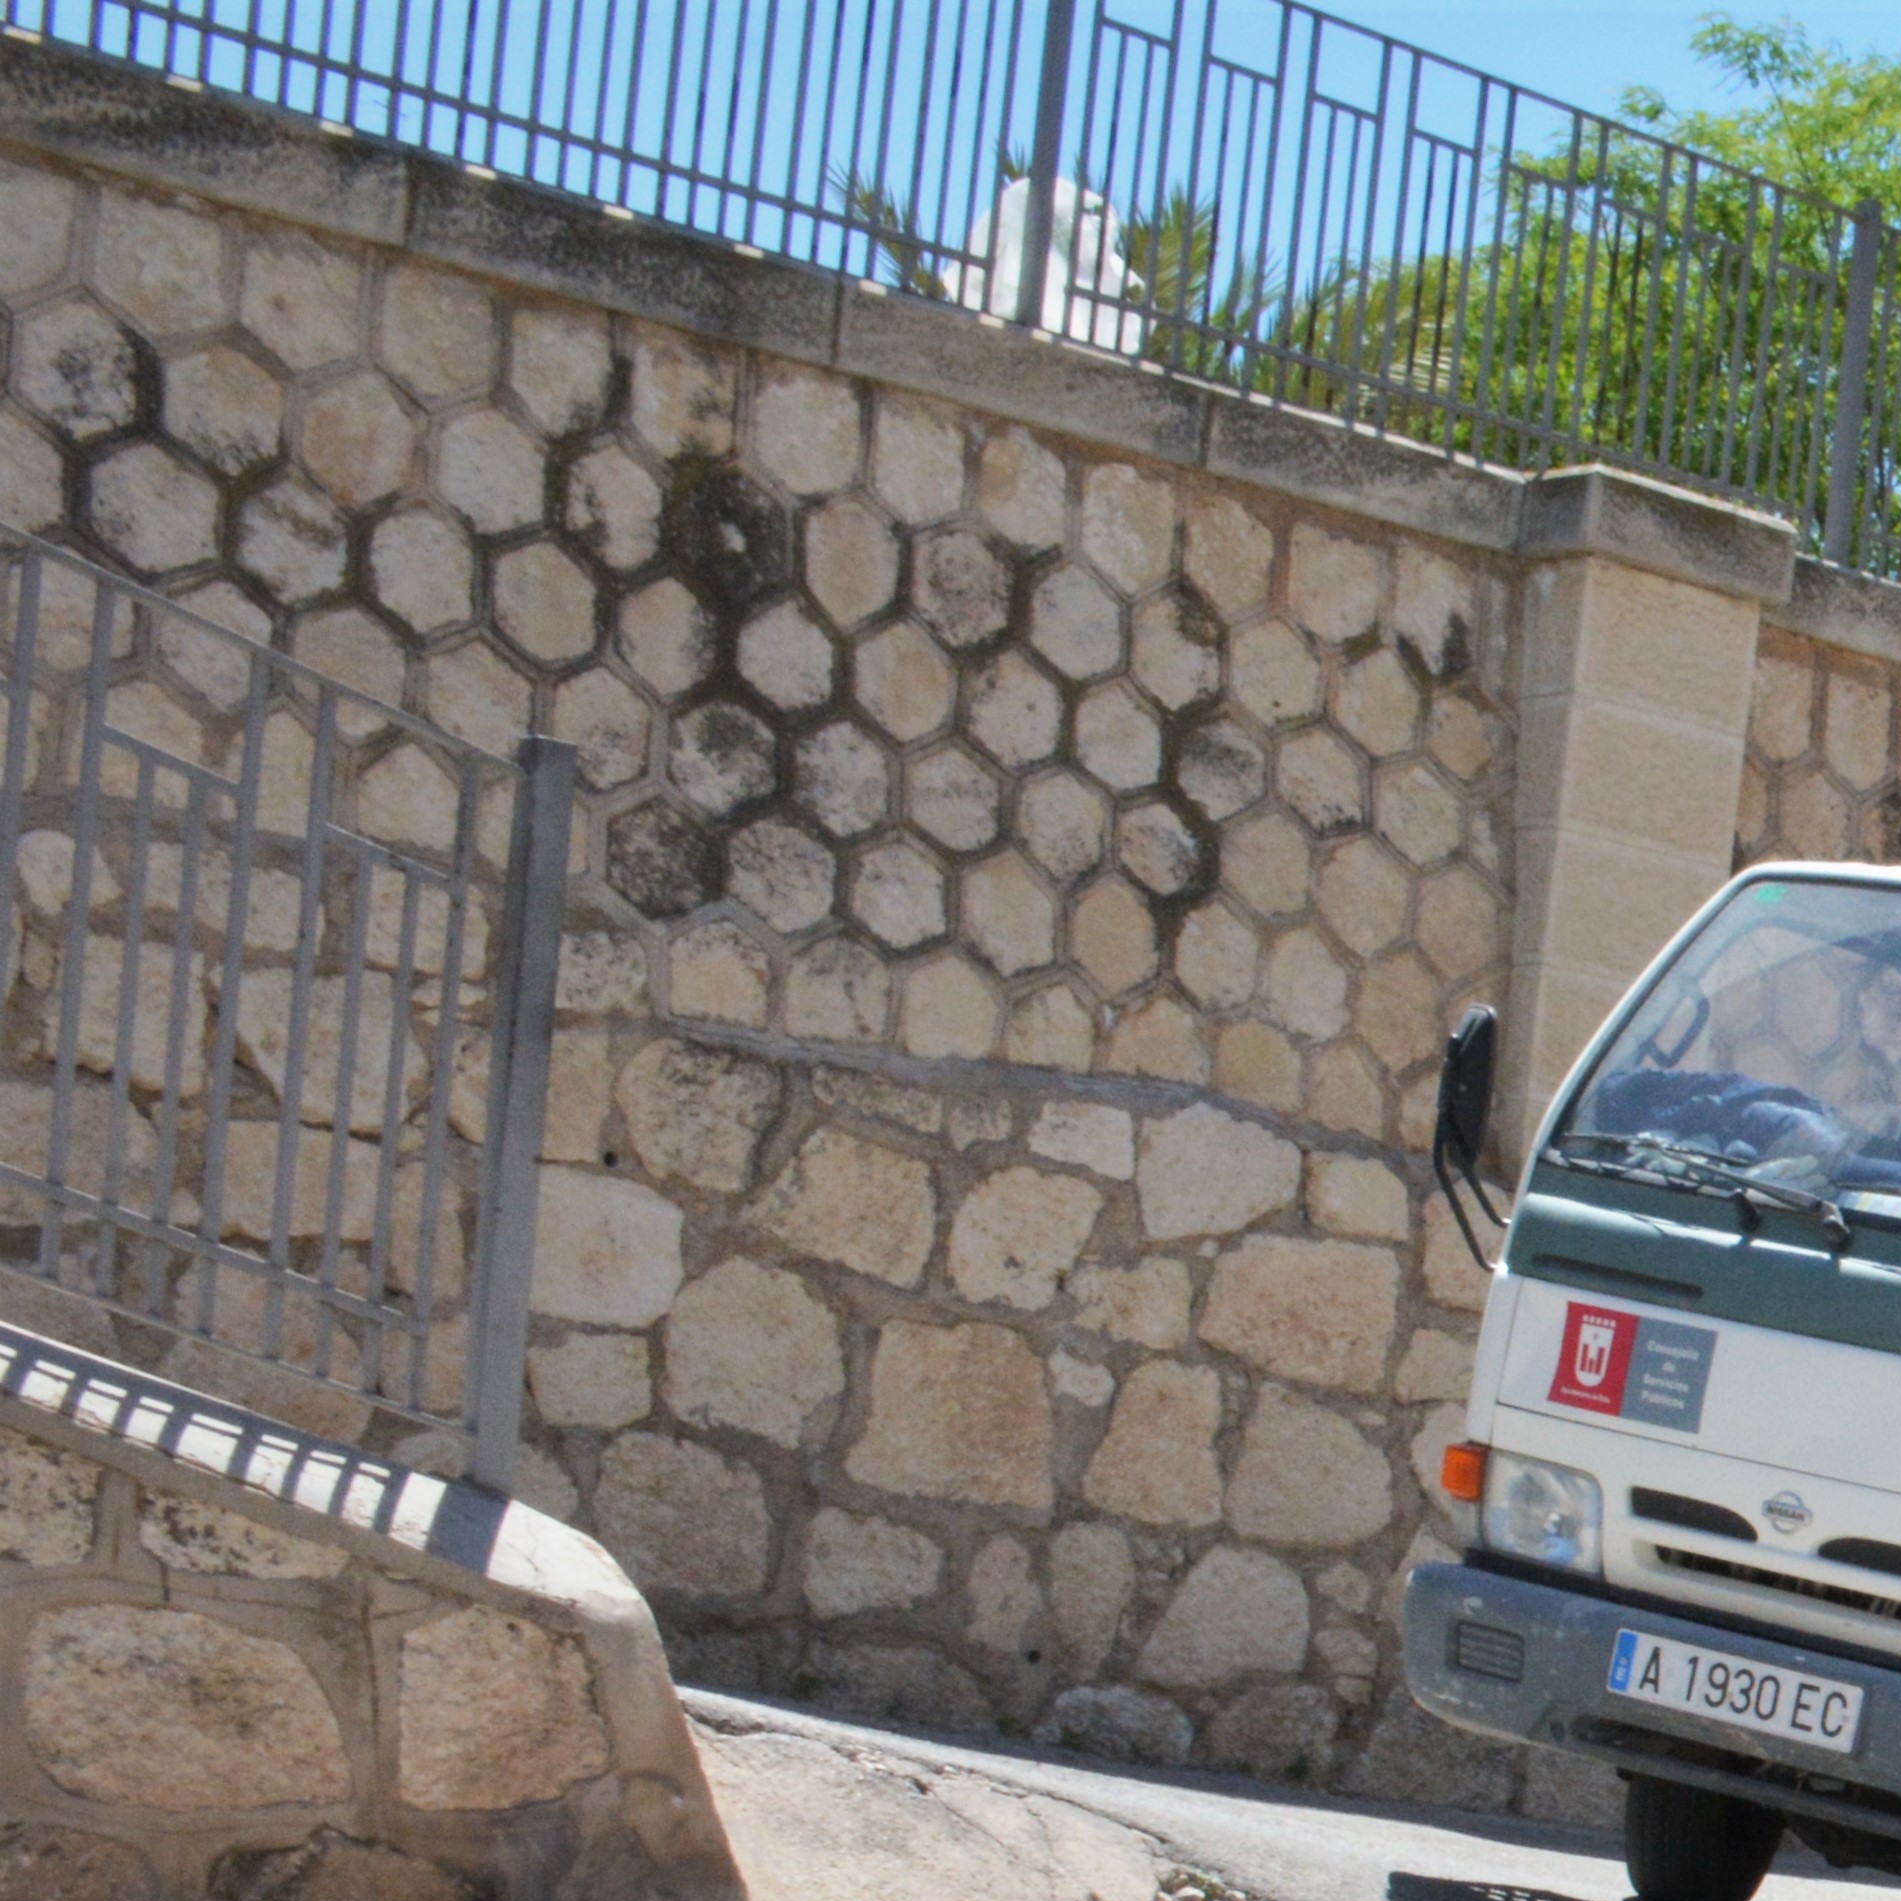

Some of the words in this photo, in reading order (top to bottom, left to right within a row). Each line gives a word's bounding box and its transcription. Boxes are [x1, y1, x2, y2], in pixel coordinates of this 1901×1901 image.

[1638, 1645, 1661, 1694] A
[1685, 1655, 1781, 1721] 1930
[1791, 1682, 1848, 1738] EC
